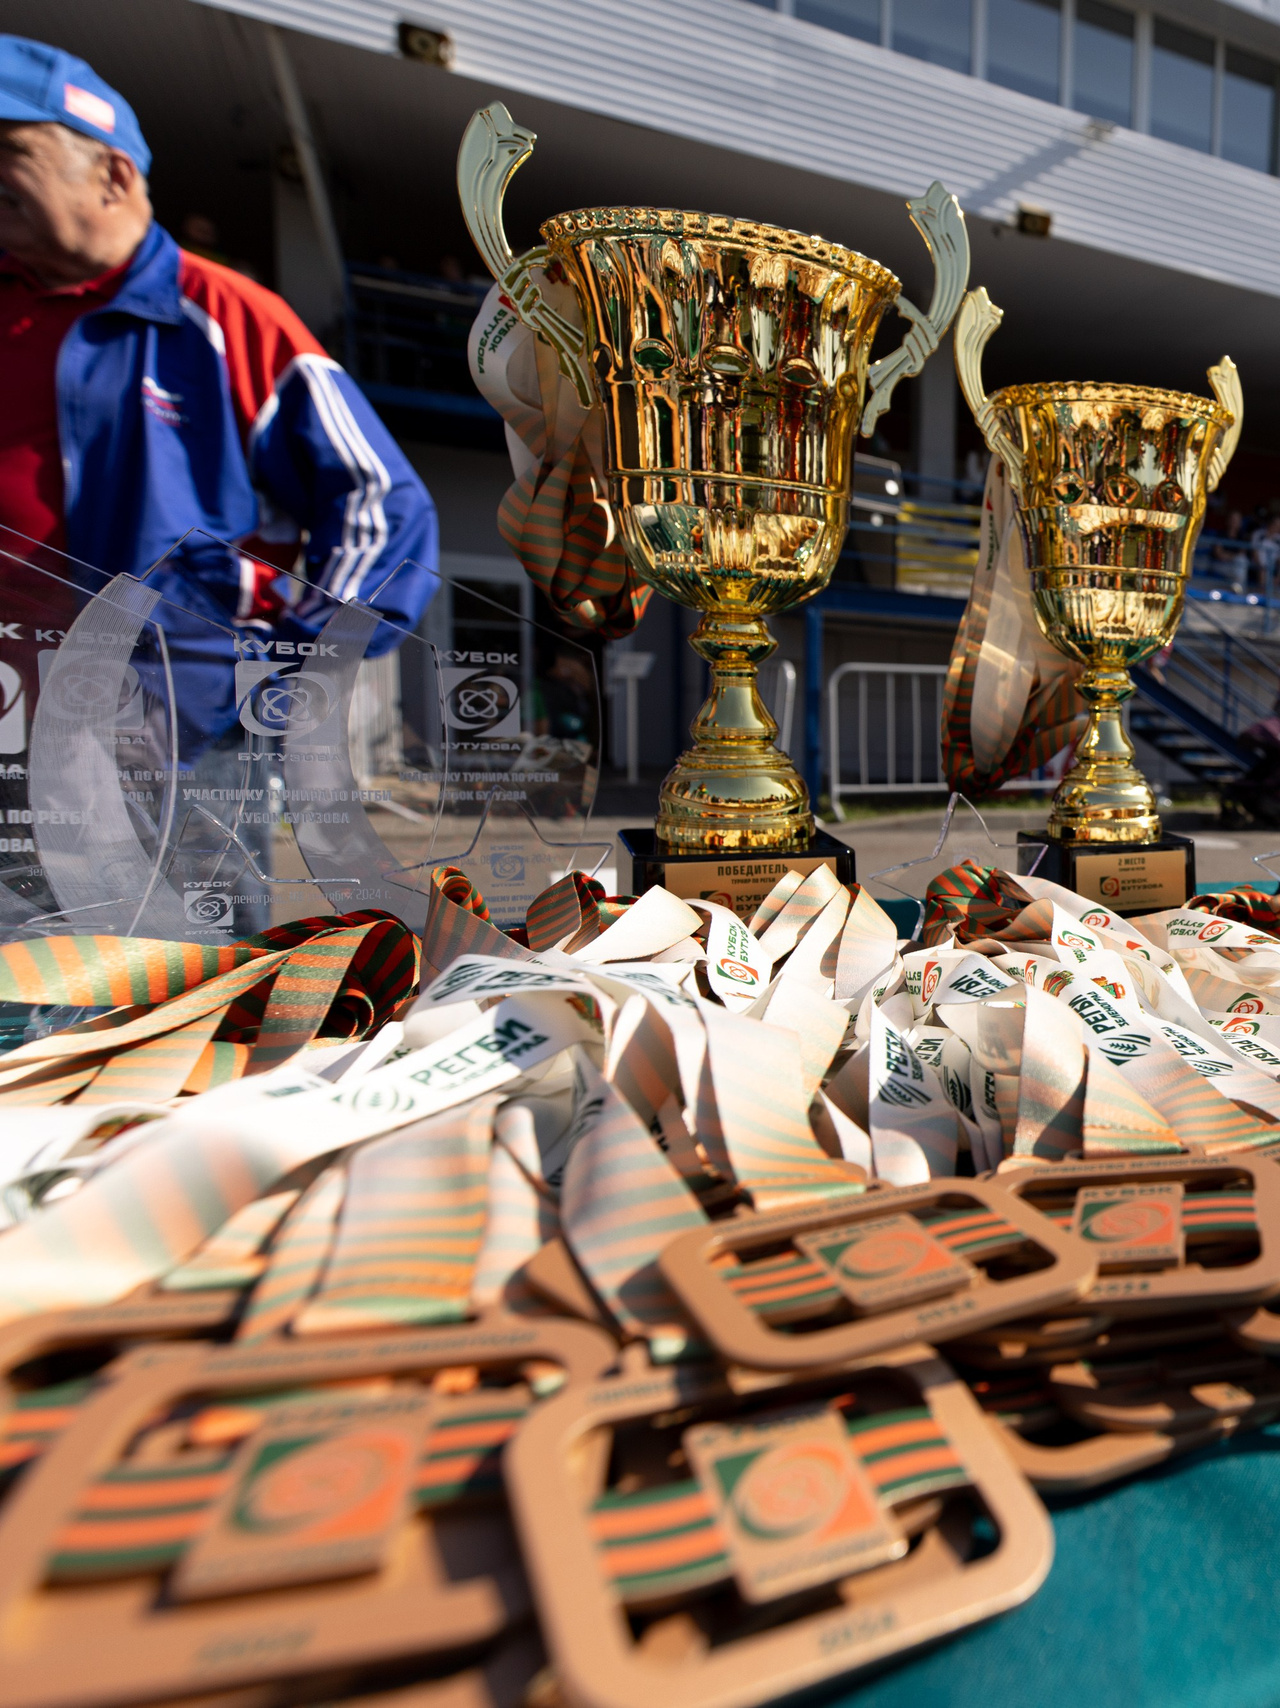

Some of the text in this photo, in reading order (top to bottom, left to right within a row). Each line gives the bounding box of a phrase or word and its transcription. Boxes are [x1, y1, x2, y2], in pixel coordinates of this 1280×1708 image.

[478, 308, 507, 374] БУТУЗОВА
[489, 315, 518, 353] КУБОК
[233, 639, 340, 657] КУБОК
[440, 650, 519, 664] КУБОК
[237, 752, 343, 763] БУТУЗОВА
[463, 773, 510, 783] ТУРНИРА
[527, 773, 559, 782] РЕГБИ
[183, 788, 263, 801] УЧАСТНИКУ
[351, 789, 392, 801] РЕГБИ
[7, 809, 33, 824] ПО
[236, 811, 350, 824] КУБОК БУТУЗОВА
[717, 864, 789, 877] ПОБЕДИТЕЛЬ
[183, 881, 232, 889] КУБОК
[1068, 994, 1117, 1034] РЕГБИ
[410, 1018, 533, 1086] РЕГБИ
